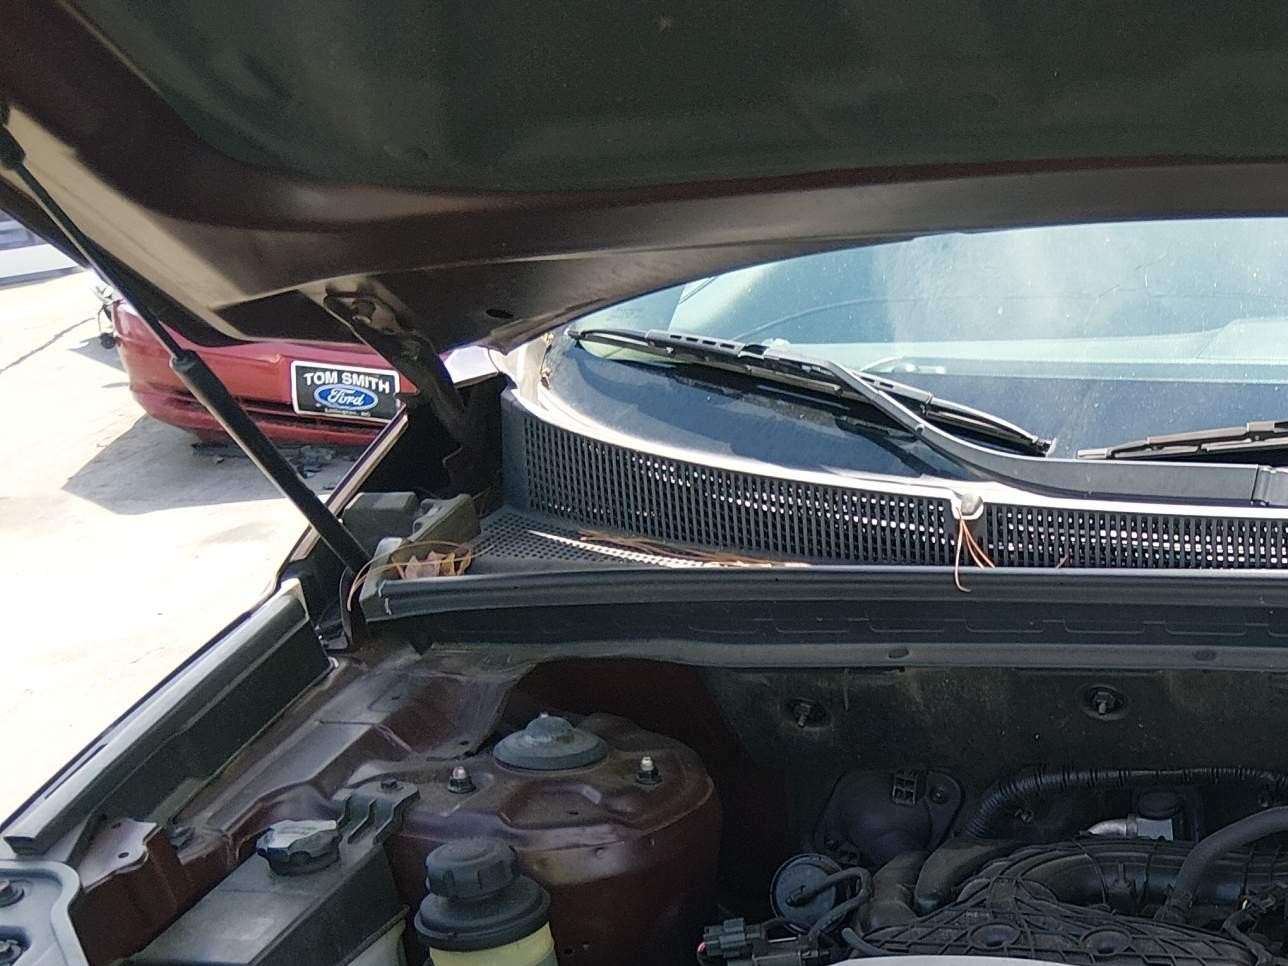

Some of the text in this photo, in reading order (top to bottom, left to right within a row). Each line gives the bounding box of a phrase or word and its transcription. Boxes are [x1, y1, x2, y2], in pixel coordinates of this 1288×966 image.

[304, 371, 390, 394] TOM SMITH
[327, 388, 365, 406] Ford
